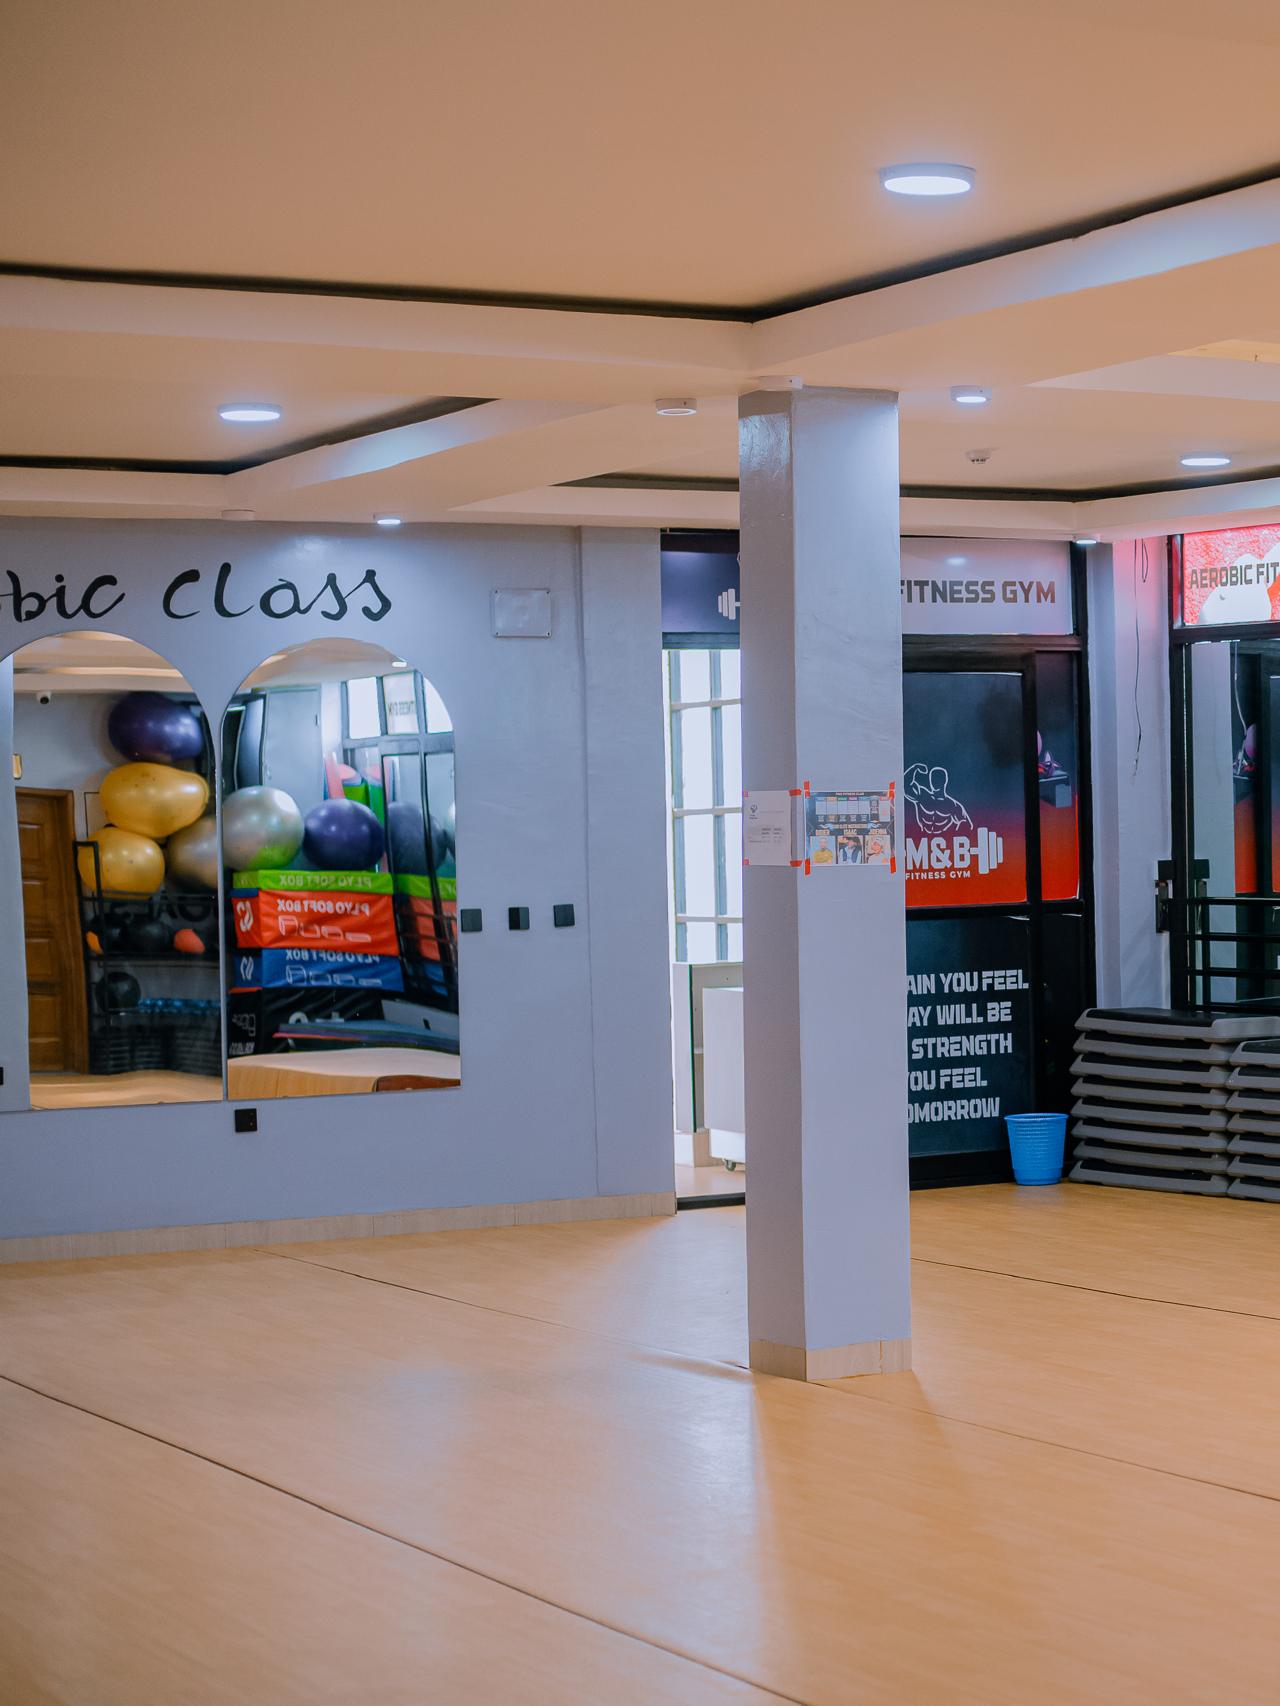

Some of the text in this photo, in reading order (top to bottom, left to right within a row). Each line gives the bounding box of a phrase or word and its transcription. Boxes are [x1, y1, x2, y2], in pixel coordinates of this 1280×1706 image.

[1190, 562, 1254, 589] AEROBIC
[0, 569, 126, 622] bic
[1002, 580, 1056, 604] GYM
[905, 836, 971, 870] M&B
[905, 870, 971, 880] FITNESS GYM
[940, 971, 979, 993] YOU
[982, 969, 1029, 991] FEEL
[936, 1003, 984, 1025] WILL
[987, 1001, 1012, 1023] BE
[911, 1032, 1013, 1060] STRENGTH
[907, 1066, 988, 1092] OU FEEL
